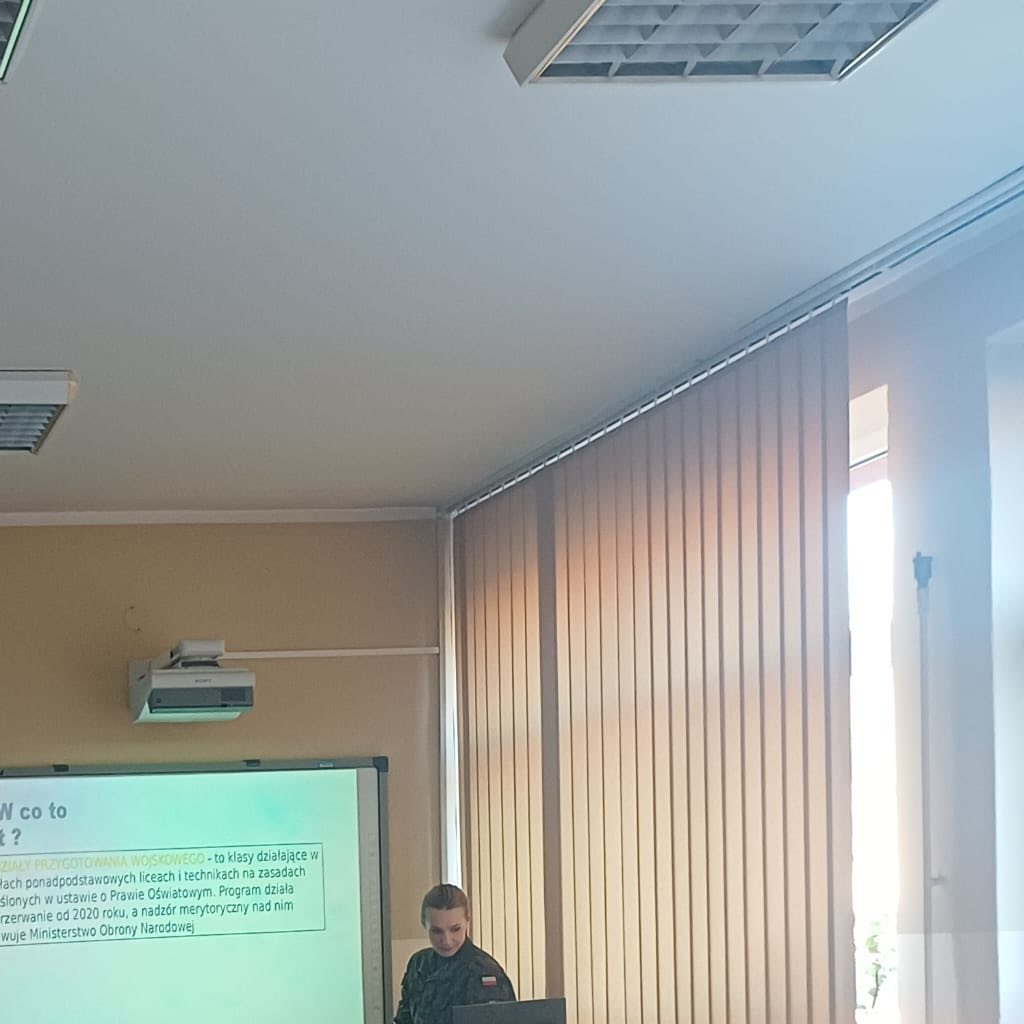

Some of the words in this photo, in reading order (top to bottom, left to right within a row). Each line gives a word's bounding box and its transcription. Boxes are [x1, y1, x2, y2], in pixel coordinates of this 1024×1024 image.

[20, 806, 42, 820] co
[49, 802, 67, 819] to
[12, 828, 22, 846] ?
[34, 856, 128, 871] PRZYGOTOWANIA
[131, 852, 205, 869] WOJSKOWEGO
[214, 853, 224, 864] to
[228, 850, 254, 865] klasy
[257, 849, 307, 864] działające
[310, 850, 318, 860] w
[26, 872, 136, 890] ponadpodstawowych
[139, 870, 175, 883] liceach
[178, 870, 182, 881] i
[184, 868, 239, 882] technikach
[243, 868, 255, 879] na
[258, 865, 306, 878] zasadach
[45, 896, 53, 905] w
[56, 891, 98, 904] ustawie
[100, 893, 106, 903] o
[110, 889, 144, 902] Prawie
[148, 886, 216, 901] Oświatowym.
[219, 884, 261, 899] Program
[264, 883, 294, 896] działa
[56, 910, 69, 922] od
[73, 907, 98, 920] 2020
[102, 906, 128, 920] roku,
[132, 906, 138, 918] a
[142, 904, 176, 917] nadzór
[180, 902, 248, 918] merytoryczny
[252, 900, 271, 912] nad
[274, 900, 294, 912] nim
[30, 926, 96, 940] Ministerstwo
[100, 922, 137, 937] Obrony
[141, 920, 195, 934] Narodowej
